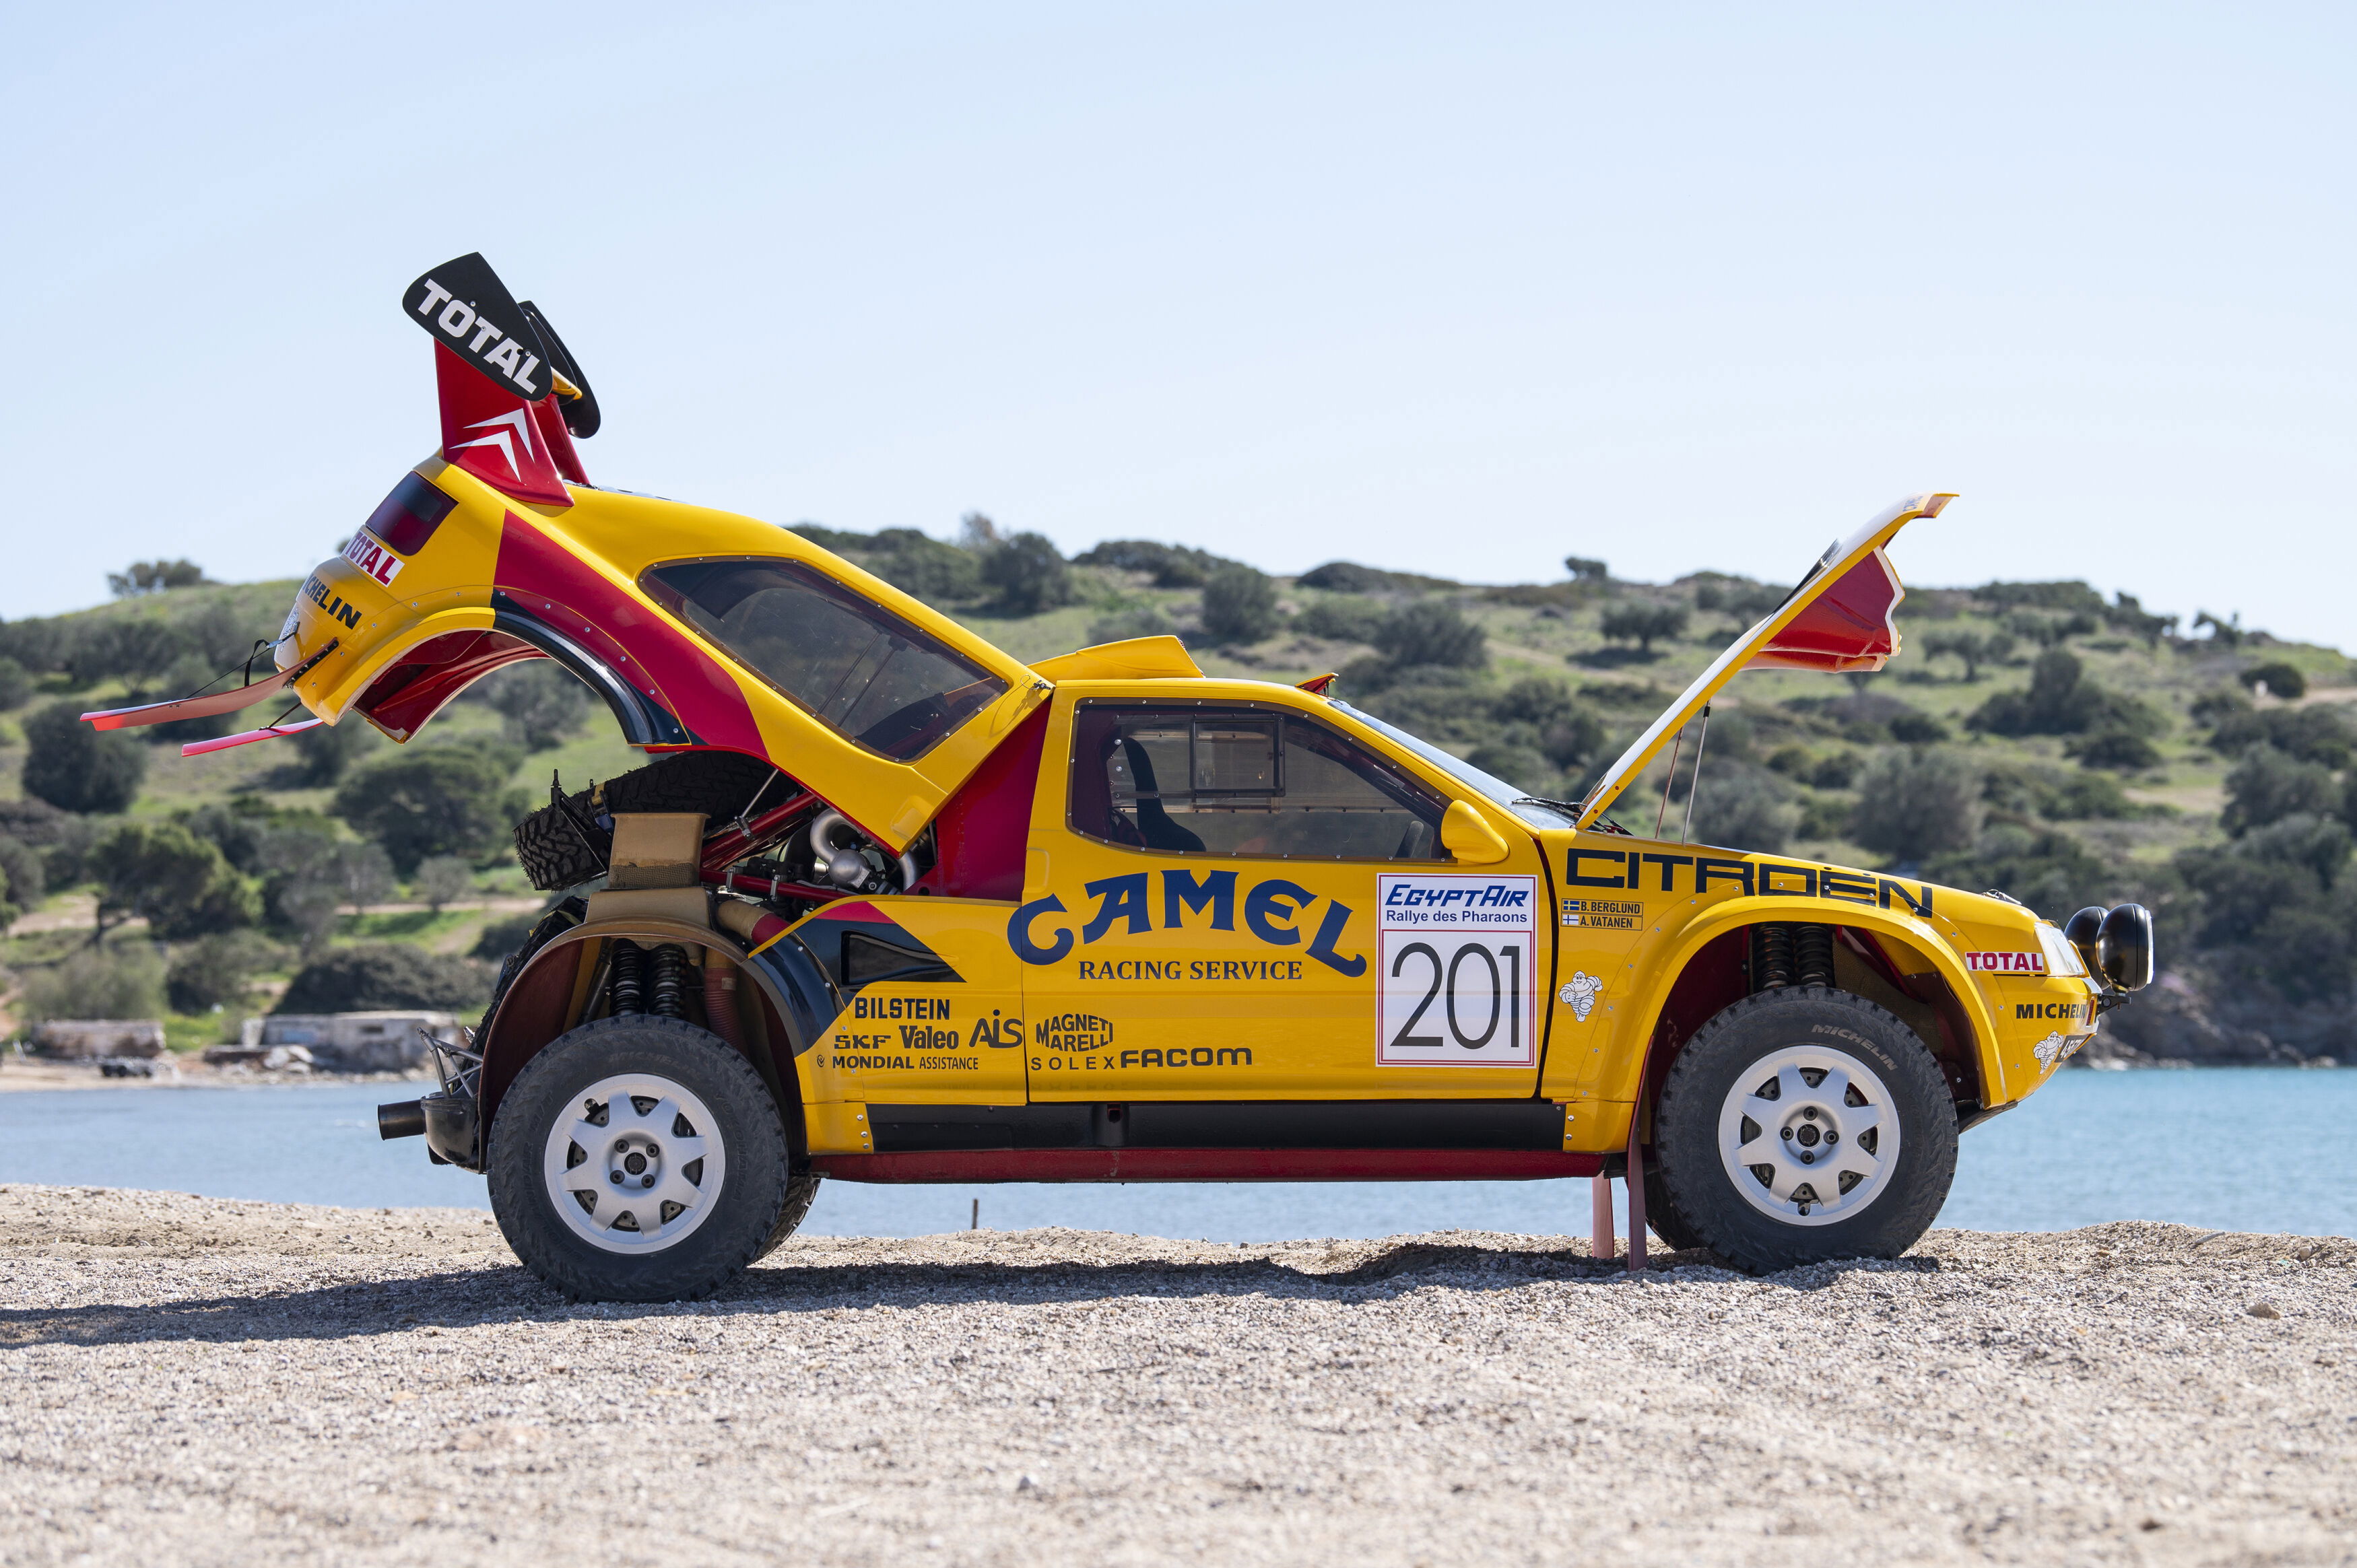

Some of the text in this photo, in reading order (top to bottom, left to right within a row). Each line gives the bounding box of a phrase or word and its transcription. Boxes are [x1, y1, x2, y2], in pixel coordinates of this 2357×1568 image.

[418, 278, 539, 394] TOTAL
[345, 531, 396, 585] TOTAL
[302, 574, 362, 629] ICHELIN
[1007, 869, 1367, 978] CAMEL
[1386, 910, 1527, 924] Rallye des Pharaons
[1591, 916, 1632, 928] VATANEN
[1078, 961, 1302, 980] RACING SERVICE
[1966, 952, 2043, 972] TOTAL
[1390, 942, 1520, 1050] 201
[855, 997, 950, 1020] BILSTEIN
[2016, 1002, 2086, 1019] MICHELIN
[834, 1035, 892, 1050] SKF
[898, 1025, 960, 1050] Valeo
[1811, 1024, 1898, 1071] MICHELIN
[832, 1056, 978, 1070] MONDIAL ASSISTANCE
[1030, 1056, 1115, 1070] SOLEX
